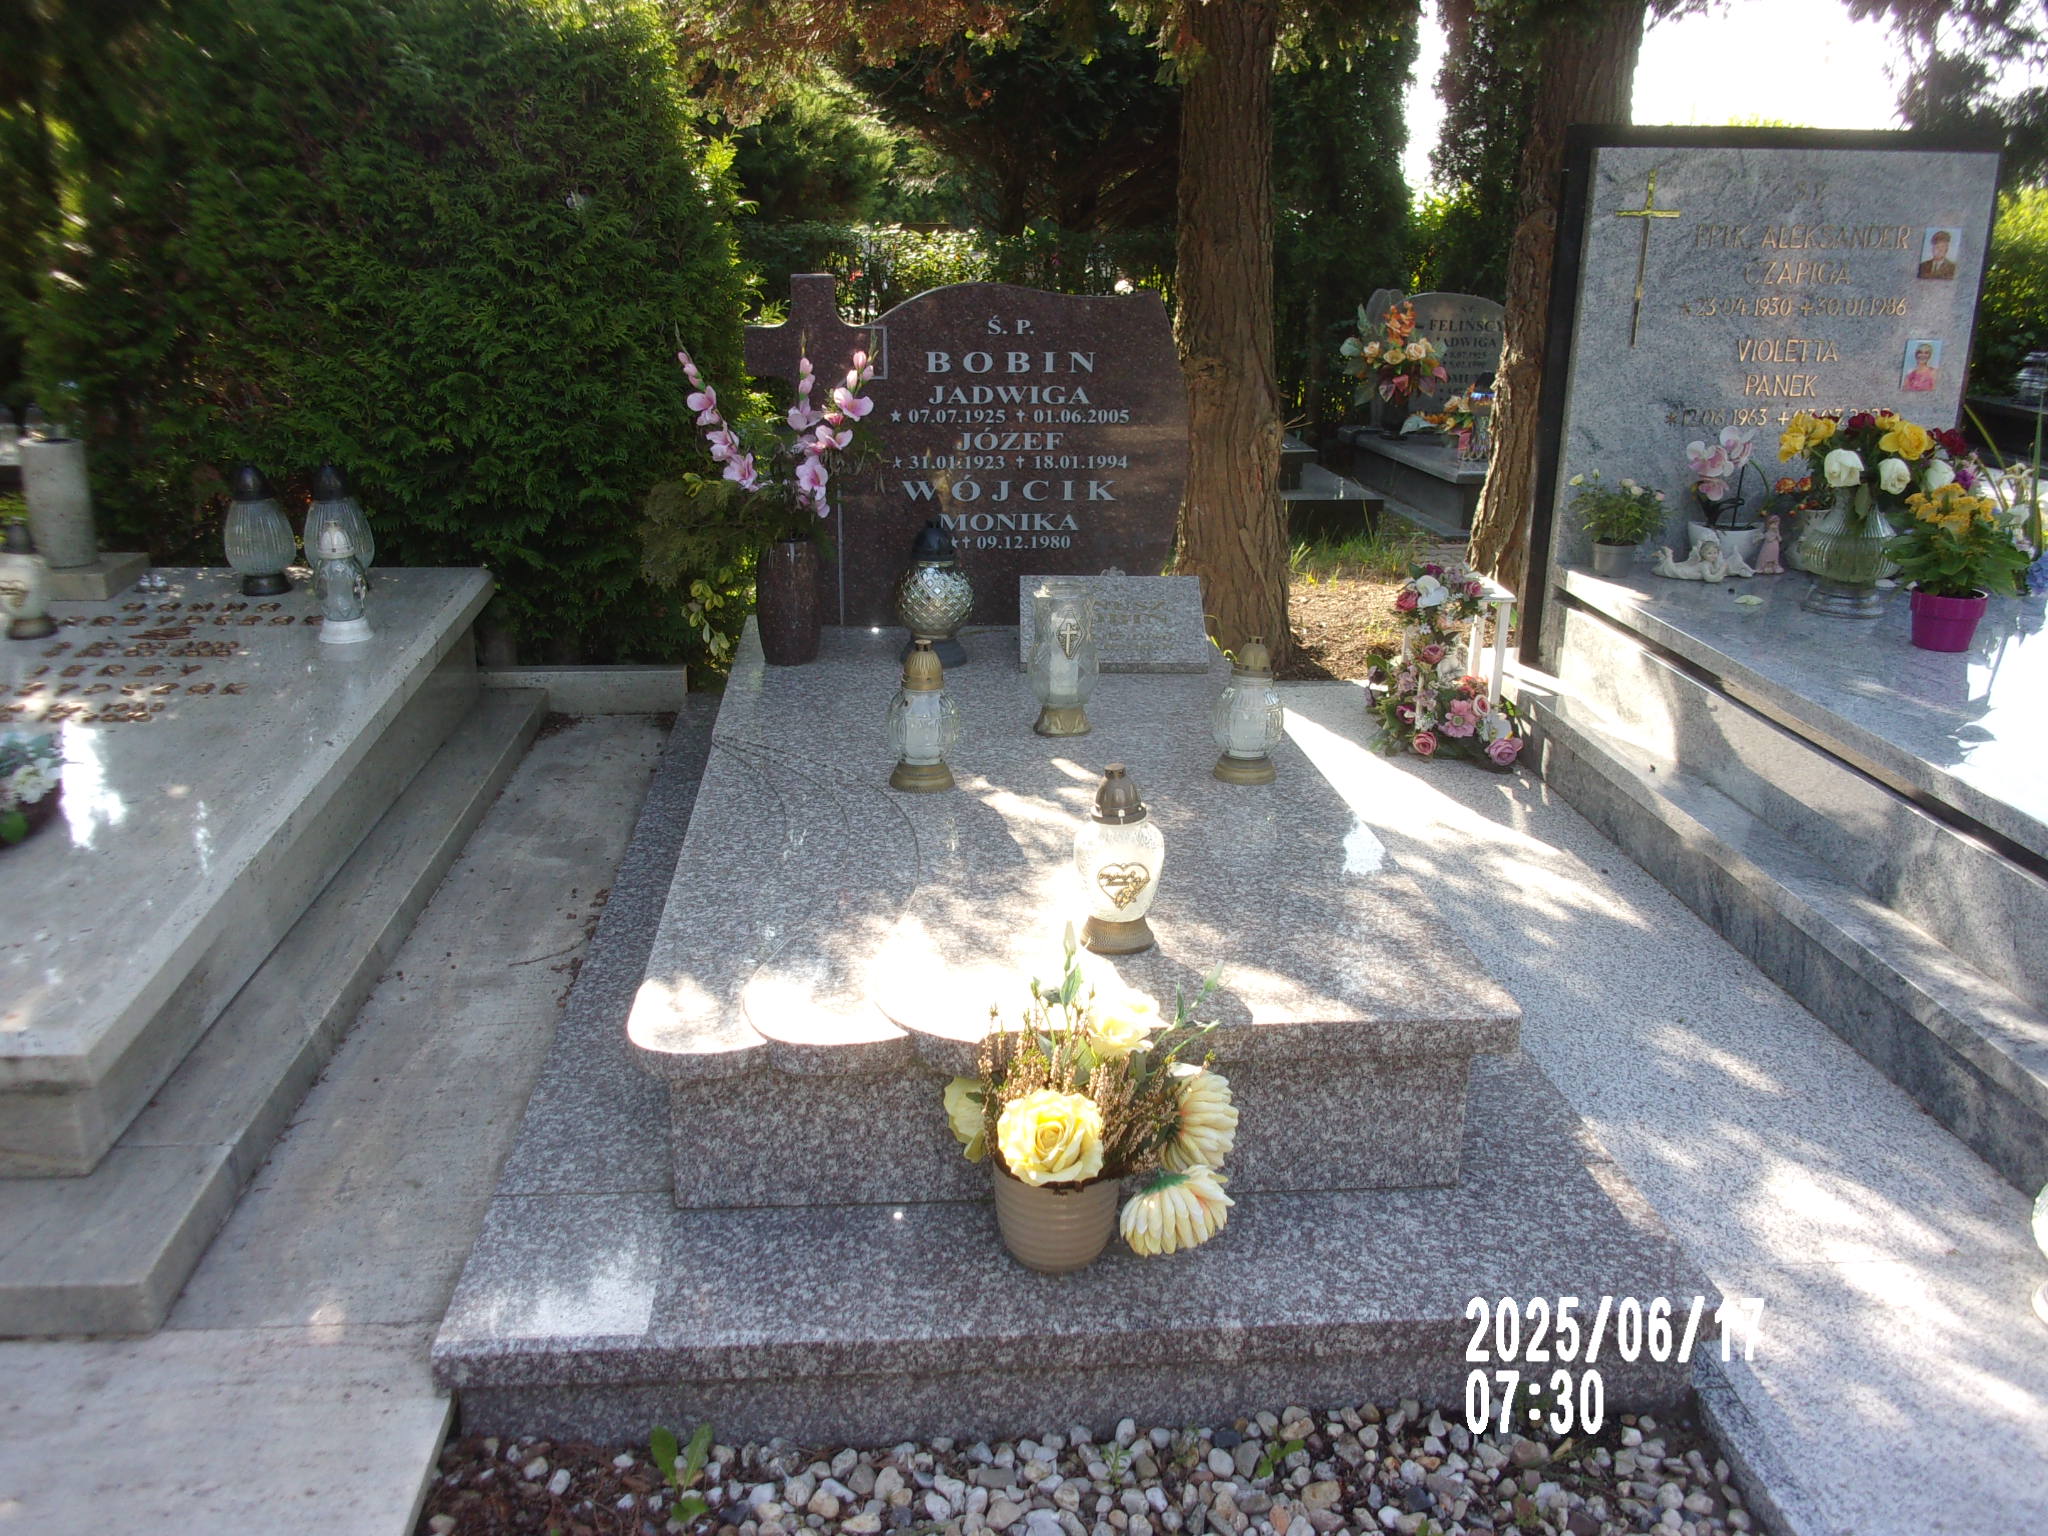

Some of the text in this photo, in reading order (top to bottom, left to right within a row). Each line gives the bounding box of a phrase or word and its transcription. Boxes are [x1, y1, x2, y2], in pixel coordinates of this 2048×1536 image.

[1761, 222, 1912, 250] ALEKSANDER
[1437, 335, 1497, 348] ADWIGA
[1737, 338, 1839, 363] VIOLETTA
[926, 351, 1096, 374] BOBIN
[928, 386, 1092, 405] JADWIGA
[1744, 374, 1818, 398] PANEK
[908, 409, 1130, 424] 07.07.1925 01.06.2005
[956, 427, 1064, 451] JÓZEF
[908, 455, 1128, 470] 31.01.1923 18.01.1994
[901, 475, 1118, 502] WÓJCIK
[939, 513, 1080, 531] MONIKA
[976, 535, 1071, 549] 09.12.1980
